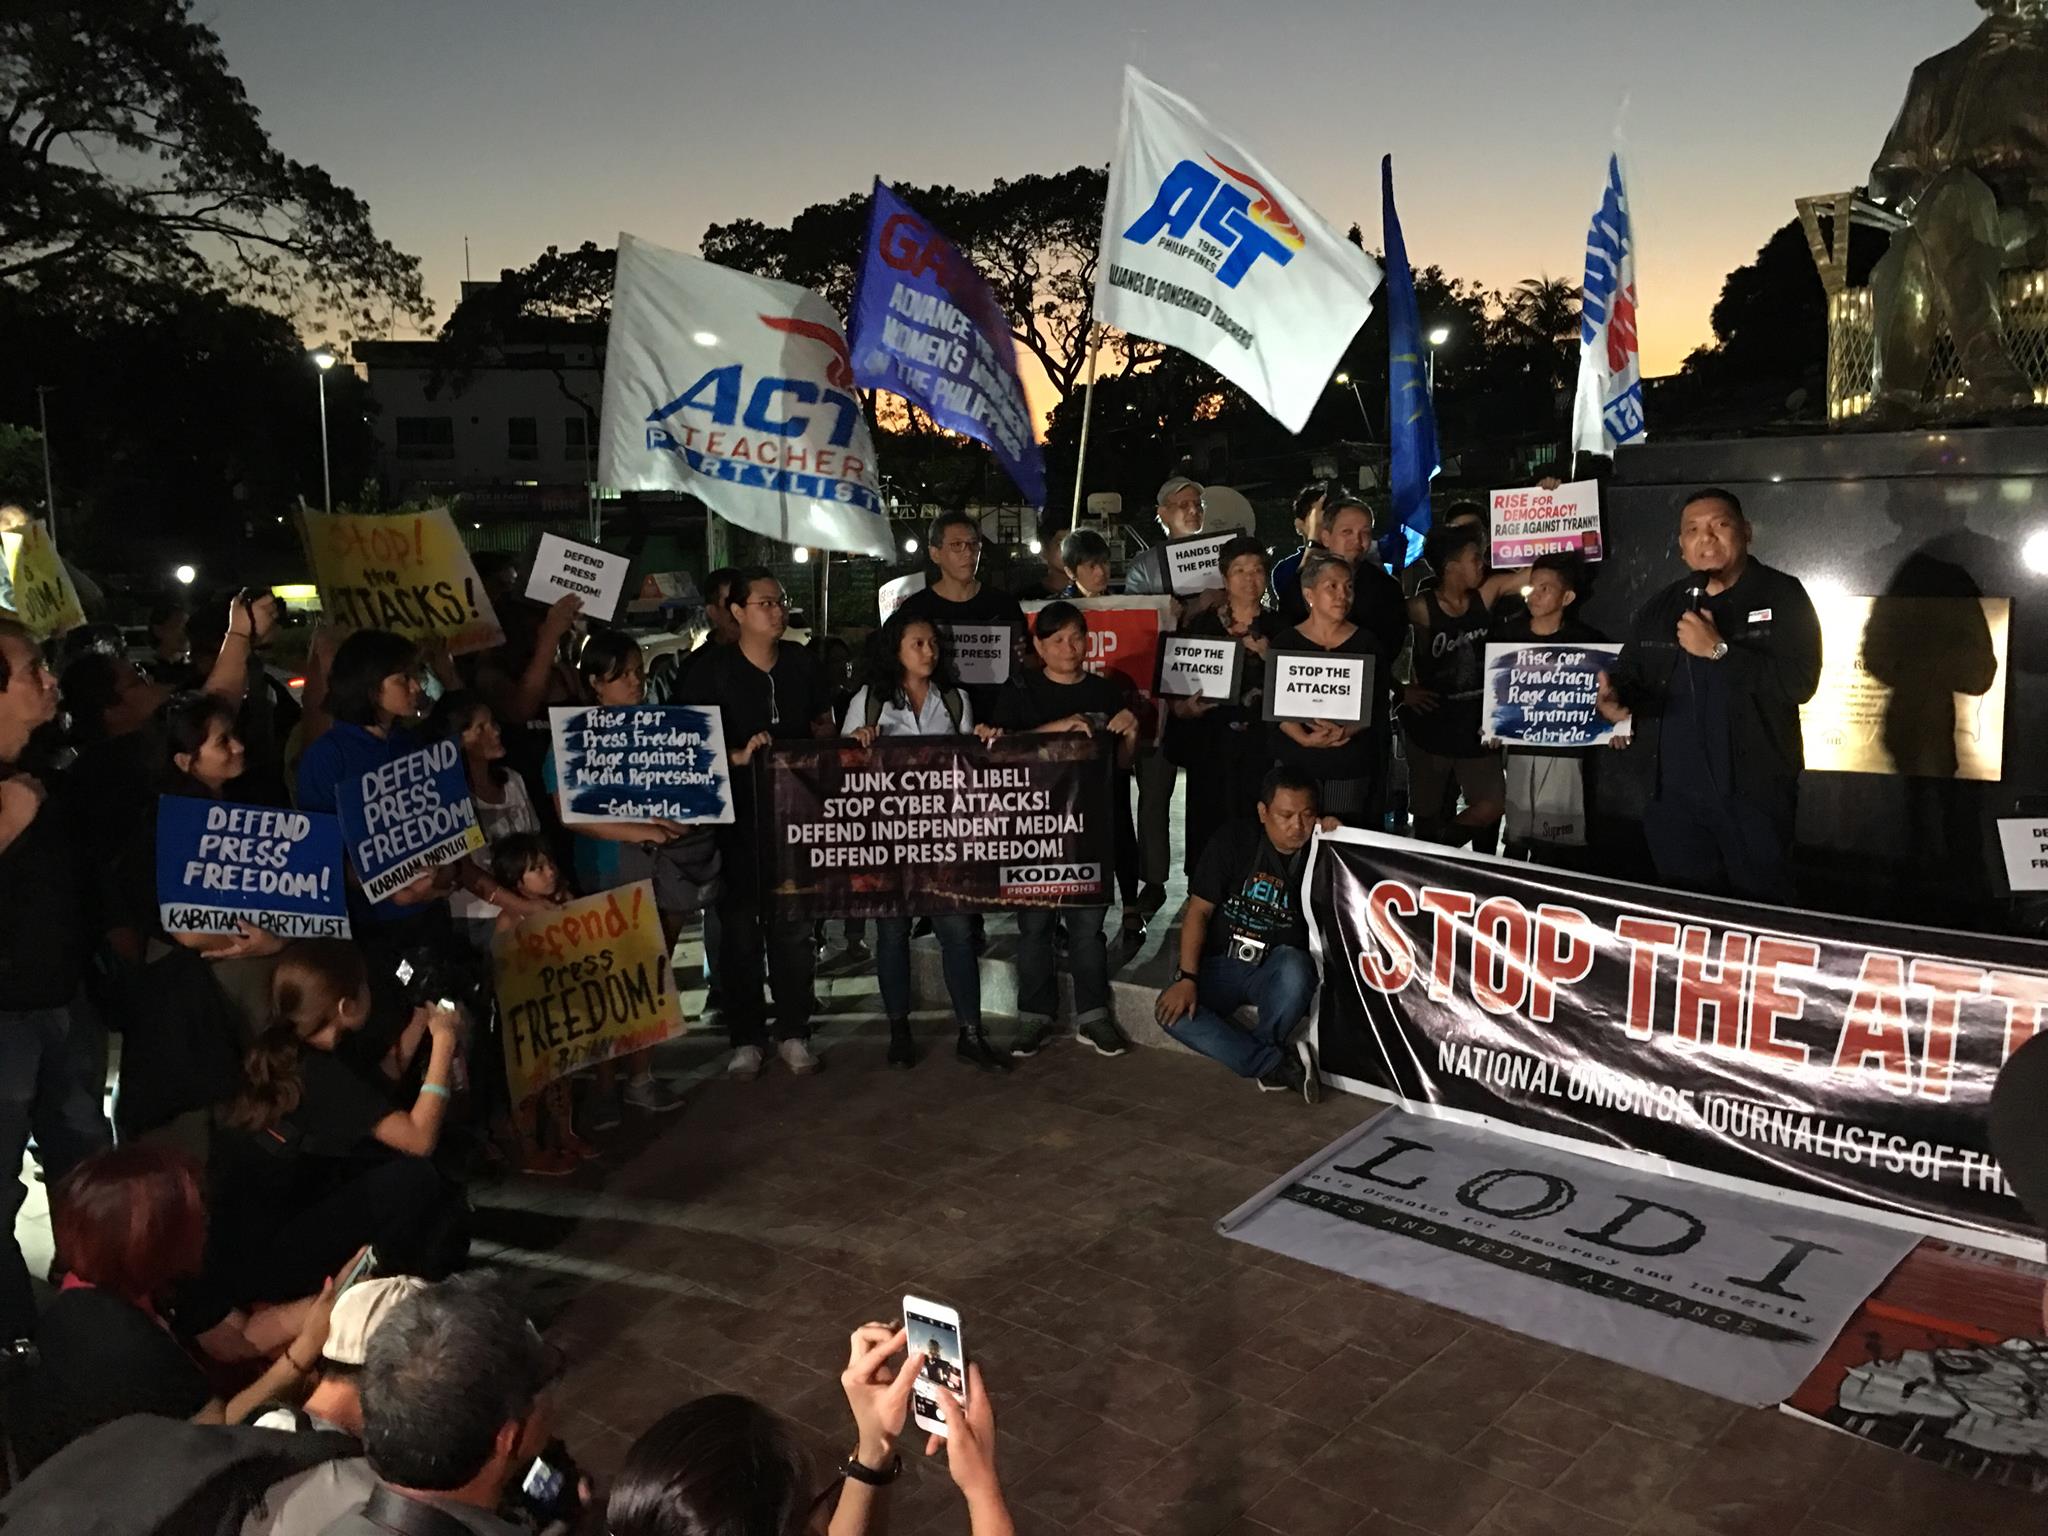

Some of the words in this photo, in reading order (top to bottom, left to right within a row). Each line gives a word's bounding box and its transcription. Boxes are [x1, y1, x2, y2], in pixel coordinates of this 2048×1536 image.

[1122, 159, 1295, 290] ACT
[1157, 236, 1218, 275] PHILIPPINES
[1197, 238, 1225, 262] 1982
[1144, 276, 1158, 298] OF
[1157, 280, 1213, 318] CONCERNED
[889, 282, 972, 342] ADVANCE
[881, 315, 968, 375] WOMEN'S
[897, 363, 932, 391] THE
[646, 364, 860, 448] ACT
[681, 424, 865, 480] TEACHER
[1494, 494, 1528, 509] RISE
[1532, 496, 1553, 506] FOR
[1504, 504, 1577, 521] DEMOCRACY!
[1495, 522, 1522, 537] RAGE
[1522, 519, 1561, 534] AGAINST
[563, 549, 604, 569] DEFEND
[1176, 544, 1211, 560] HANDS
[1500, 541, 1575, 559] GABRIELA
[362, 569, 400, 586] the
[563, 564, 597, 582] PRESS
[1177, 562, 1197, 573] THE
[1198, 558, 1220, 569] PRE
[550, 575, 602, 598] FREEDOM!
[329, 577, 479, 629] ATTACKS!
[980, 634, 1001, 644] OFF
[961, 648, 1002, 659] PRESS!
[1174, 646, 1202, 658] STOP
[1203, 648, 1224, 660] THE
[1516, 650, 1552, 666] Rise
[1555, 652, 1586, 675] for
[1171, 662, 1223, 676] ATTACKS!
[1288, 665, 1323, 677] STOP
[1325, 667, 1351, 679] THE
[1286, 682, 1351, 696] ATTACKS!
[1507, 686, 1545, 705] Rage
[1547, 688, 1598, 709] agains
[586, 707, 627, 728] Rise
[630, 710, 666, 727] for
[1520, 705, 1596, 727] Tyranny!
[582, 729, 628, 748] Press
[361, 740, 458, 803] DEFEND
[585, 749, 624, 770] Rage
[628, 748, 698, 769] against
[576, 768, 625, 786] Media
[628, 766, 716, 790] Repression!
[841, 773, 896, 794] JUNK
[900, 770, 967, 790] CYBER
[972, 767, 1030, 789] LIBEL!
[364, 777, 441, 836] PRESS
[823, 799, 874, 818] STOP
[879, 795, 946, 815] CYBER
[951, 791, 1050, 813] ATTACKS!
[206, 806, 310, 842] DEFEND
[358, 797, 476, 873] FREEDOM!
[787, 822, 866, 844] DEFEND
[871, 816, 1010, 841] INDEPENDENT
[1015, 813, 1084, 835] MEDIA!
[199, 834, 291, 869] PRESS
[426, 835, 468, 868] PARTYLIST
[810, 846, 888, 868] DEFEND
[894, 841, 957, 864] PRESS
[963, 837, 1064, 861] FREEDOM!
[183, 861, 330, 903] FREEDOM!
[1006, 866, 1096, 883] KODAO
[1006, 883, 1096, 895] PRODUCTIONS
[258, 911, 346, 937] PARTYLIST
[1358, 879, 1595, 1023] STOP
[1613, 914, 1821, 1066] THE
[507, 953, 667, 1068] FREEDOM!
[1438, 1041, 1563, 1098] NATIONAL
[1701, 1094, 1908, 1174] JOURNALISTS
[1909, 1141, 1954, 1182] OF
[1957, 1149, 2016, 1197] TH
[1333, 1135, 1844, 1303] LODI
[1296, 1189, 1366, 1216] ARTS
[1381, 1214, 1438, 1237] AND
[1456, 1236, 1554, 1272] MEDIA
[1577, 1273, 1759, 1333] ALLIANCE
[1362, 1187, 1450, 1217] Organize
[1462, 1216, 1497, 1230] for
[1508, 1228, 1621, 1267] Democracy
[1632, 1265, 1674, 1283] and
[1688, 1281, 1815, 1325] Integrity
